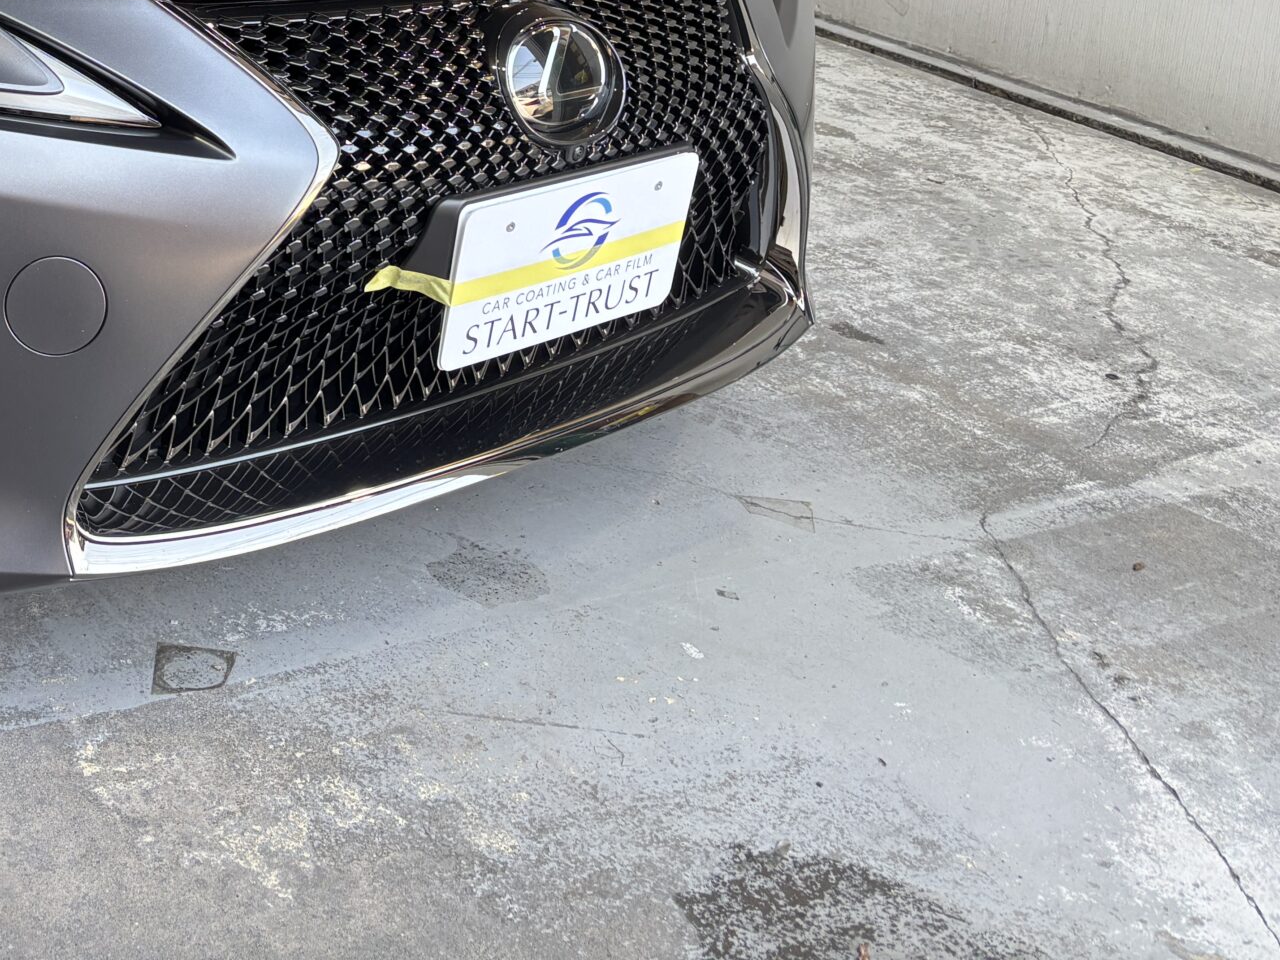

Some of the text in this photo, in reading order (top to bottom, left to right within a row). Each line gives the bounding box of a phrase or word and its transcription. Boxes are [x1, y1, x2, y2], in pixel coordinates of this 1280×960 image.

[462, 269, 659, 355] START-TRUST
[481, 253, 653, 315] CAR COATING & CAR FILM
